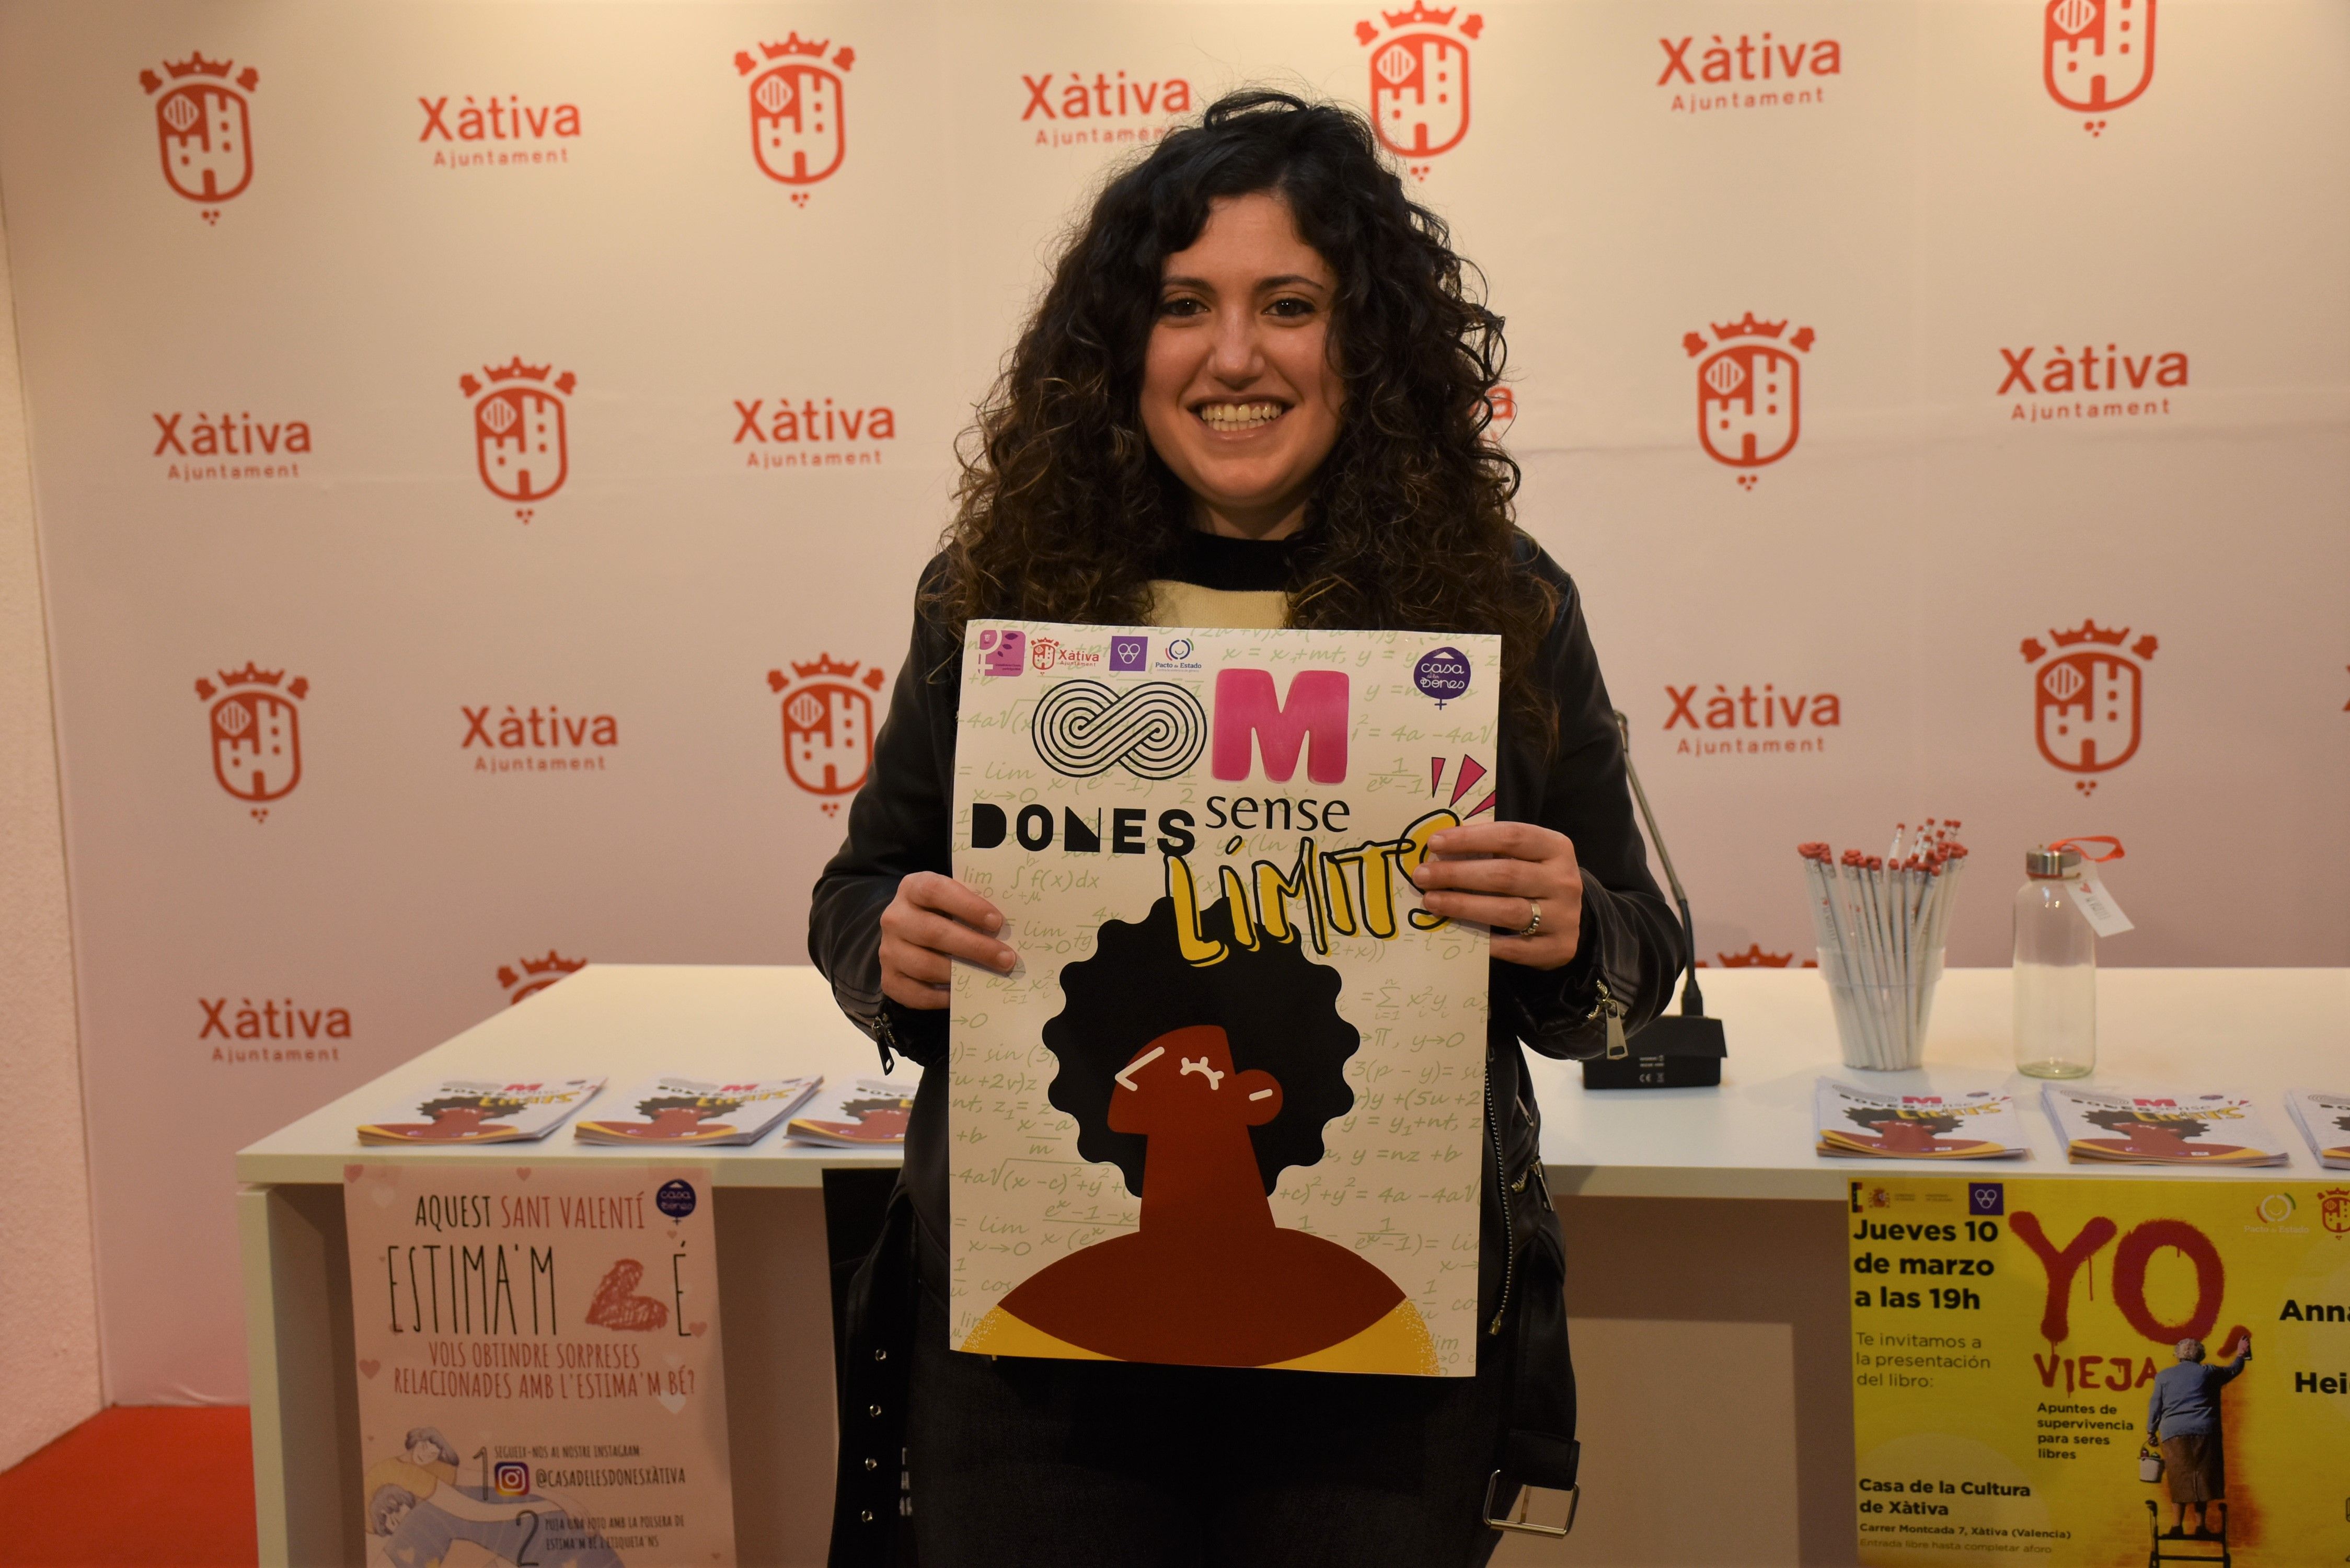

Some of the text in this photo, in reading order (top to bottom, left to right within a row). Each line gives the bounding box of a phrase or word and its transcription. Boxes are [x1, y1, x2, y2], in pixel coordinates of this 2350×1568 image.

[1657, 32, 1841, 86] Xàtiva
[1021, 71, 1191, 121] Xàtiva
[1672, 87, 1825, 113] Ajuntament
[418, 95, 582, 143] Xàtiva
[1035, 124, 1175, 147] Ajuntamen
[433, 147, 569, 169] Ajuntament
[1997, 343, 2189, 396] Xàtiva
[732, 398, 896, 444] Xàtiva
[2011, 398, 2170, 423] Ajuntament
[153, 413, 312, 456] Xàtiva
[746, 449, 883, 470] Ajuntament
[167, 463, 300, 482] Ajuntament
[1058, 649, 1099, 662] Xàtiva
[1663, 684, 1841, 730] Xàtiva
[460, 705, 618, 750] Xàtiva
[1677, 736, 1825, 758] Ajuntament
[475, 755, 606, 774] Ajuntament
[972, 795, 1350, 857] DONES sense
[198, 997, 352, 1040] Xàtiva
[211, 1046, 340, 1064] Ajuntament
[415, 1191, 646, 1232] AQUEST SANT VALENTÍ
[1853, 1219, 1998, 1242] Jueves 10
[1854, 1252, 1994, 1276] de marzo
[1854, 1286, 1980, 1309] a las 19h
[2279, 1299, 2350, 1322] Ann
[1856, 1332, 1982, 1348] Te invitamos a
[429, 1342, 640, 1369] VOLS OBTINDRE SORPRESES
[1857, 1352, 1991, 1369] la presentación
[394, 1368, 512, 1399] RELACIONADES
[519, 1373, 554, 1399] AMB
[668, 1365, 695, 1396] BÉ?
[1857, 1373, 1933, 1388] del libro:
[2033, 1353, 2157, 1398] VIEJA
[2295, 1371, 2350, 1394] Hei
[2037, 1402, 2117, 1415] Apuntes de
[2037, 1419, 2134, 1431] supervivencia
[2038, 1434, 2110, 1445] para seres
[494, 1445, 548, 1459] SEGUEIX-NOS
[551, 1445, 559, 1457] AL
[563, 1446, 590, 1458] NOSTRE
[2038, 1449, 2076, 1460] libres
[1859, 1478, 2031, 1496] Casa de la Cultura
[1860, 1500, 1949, 1516] de Xàtiva
[515, 1510, 539, 1566] 2
[546, 1518, 565, 1530] PUJA
[588, 1518, 607, 1529] FOTO
[609, 1517, 625, 1529] AMB
[628, 1517, 637, 1528] LA
[640, 1516, 672, 1528] POLSERA
[675, 1515, 684, 1526] DE
[1860, 1524, 1896, 1533] Carrer
[1899, 1525, 1954, 1535] Montcada
[1972, 1527, 2008, 1537] Xàtiva
[2011, 1529, 2071, 1540] (Valencia)
[1860, 1539, 2052, 1554] Entrada libre hasta completar aforo
